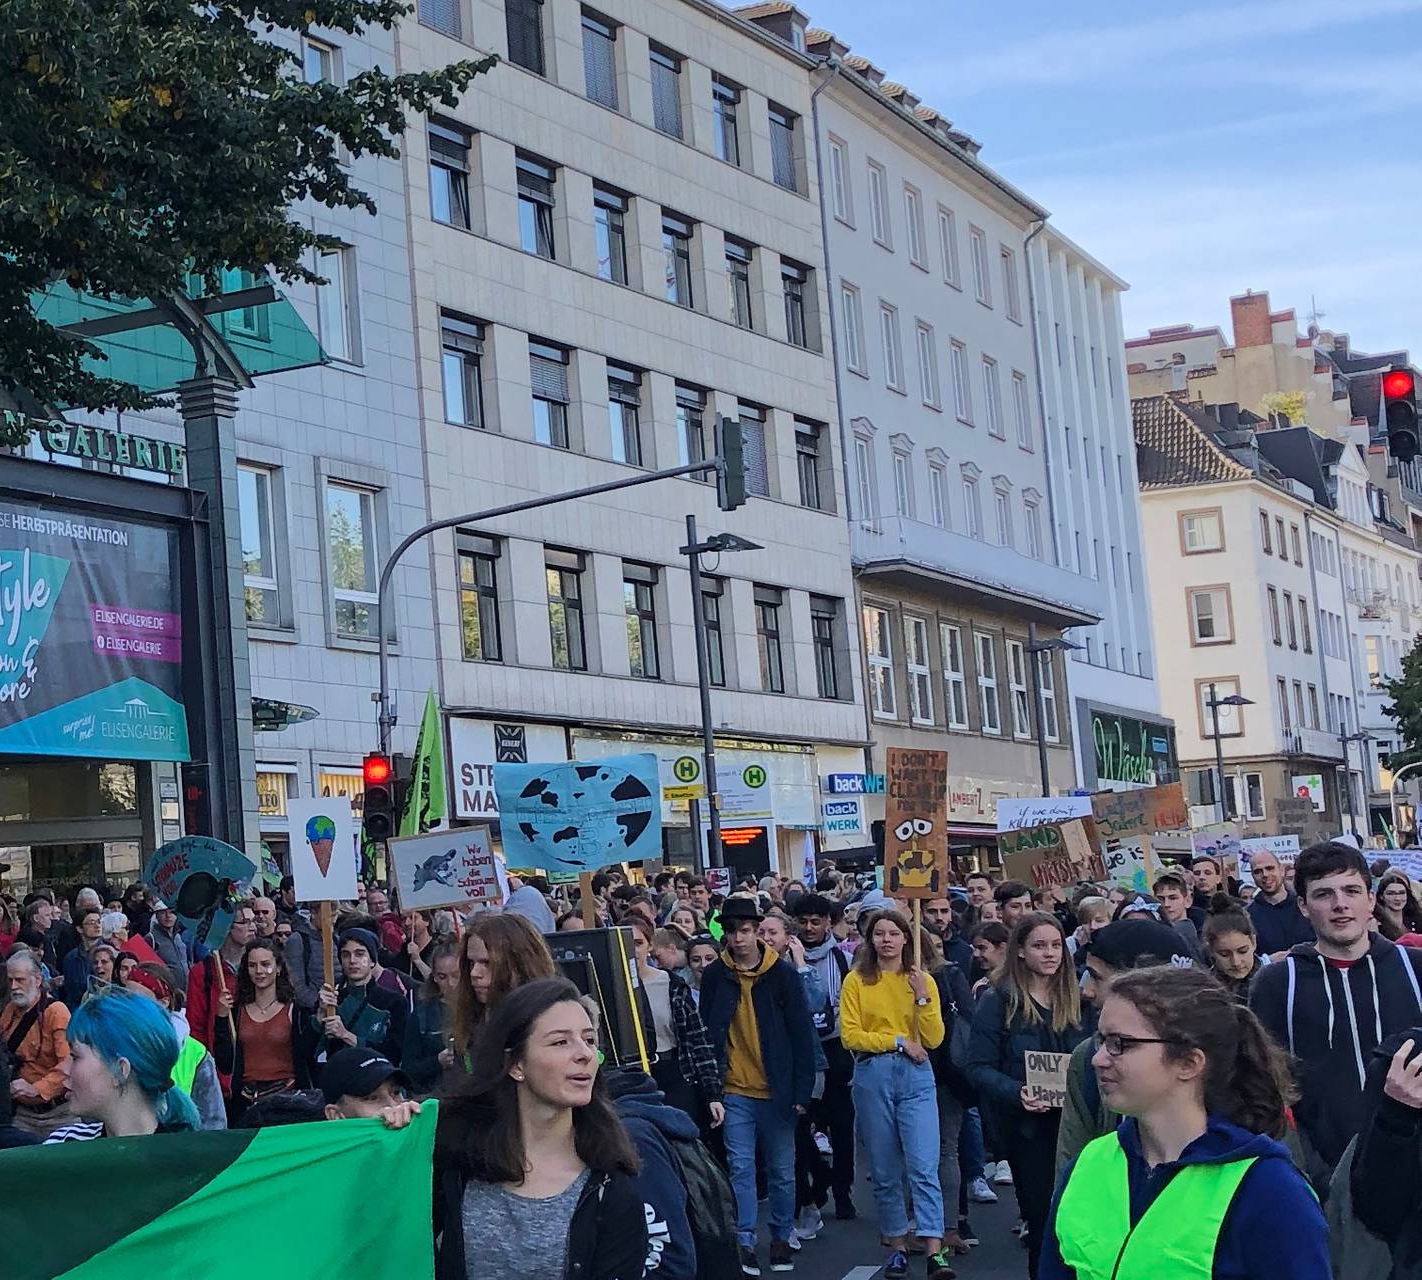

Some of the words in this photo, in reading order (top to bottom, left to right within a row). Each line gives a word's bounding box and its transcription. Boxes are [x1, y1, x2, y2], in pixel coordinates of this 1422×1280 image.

[46, 419, 186, 474] GALERIE
[12, 513, 128, 547] HERBSTPRÄSENTATION
[95, 609, 165, 630] ELISENGALERIE.DE
[106, 636, 163, 655] ELISENGALERIE
[101, 721, 176, 742] ELISENGALERIE
[826, 803, 857, 815] back
[827, 819, 860, 831] WERK
[465, 843, 482, 855] Wir
[462, 854, 492, 868] haben
[468, 867, 481, 878] die
[457, 876, 496, 889] Schnauze
[465, 885, 486, 898] voll
[1028, 1053, 1063, 1073] ONLY
